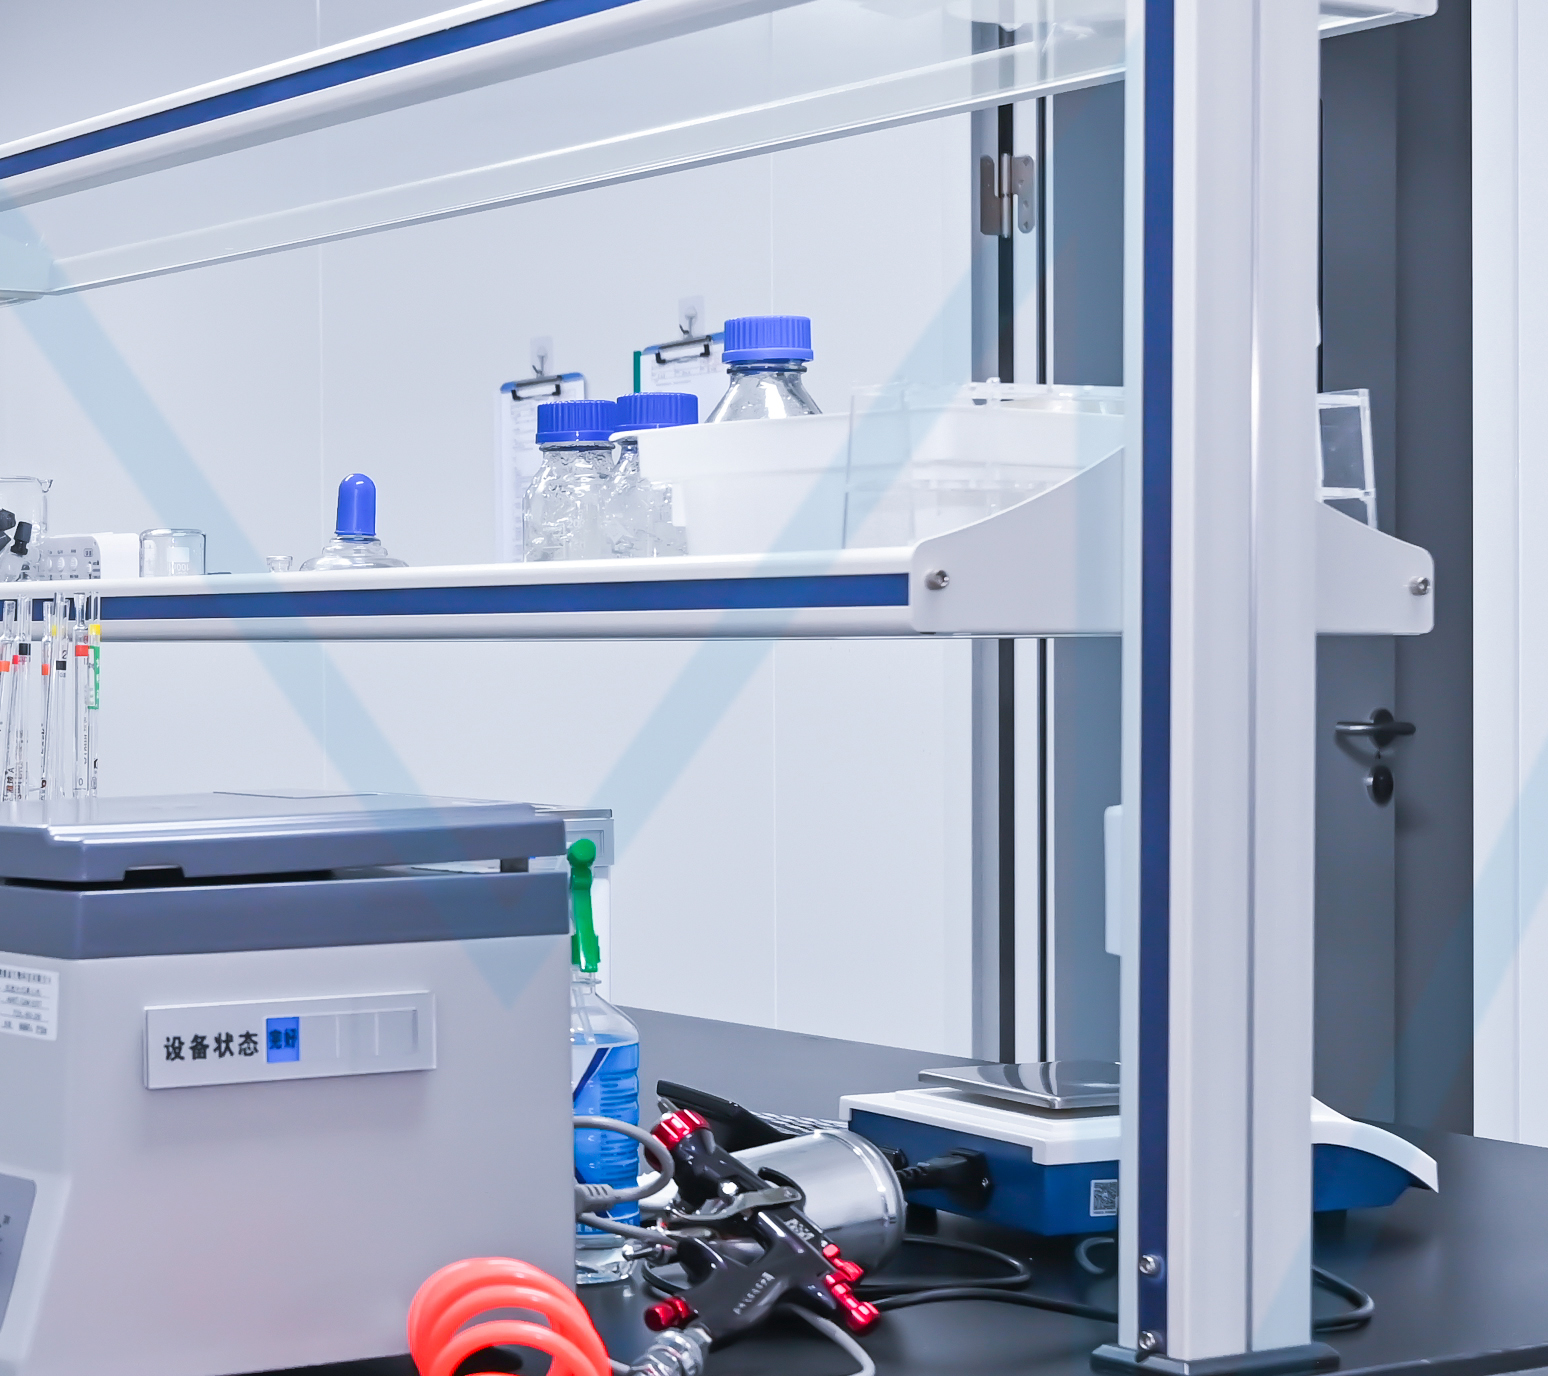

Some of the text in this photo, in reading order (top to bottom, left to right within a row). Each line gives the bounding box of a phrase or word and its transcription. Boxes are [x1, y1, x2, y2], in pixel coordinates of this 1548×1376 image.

[163, 1027, 298, 1061] 设备状态 完好
